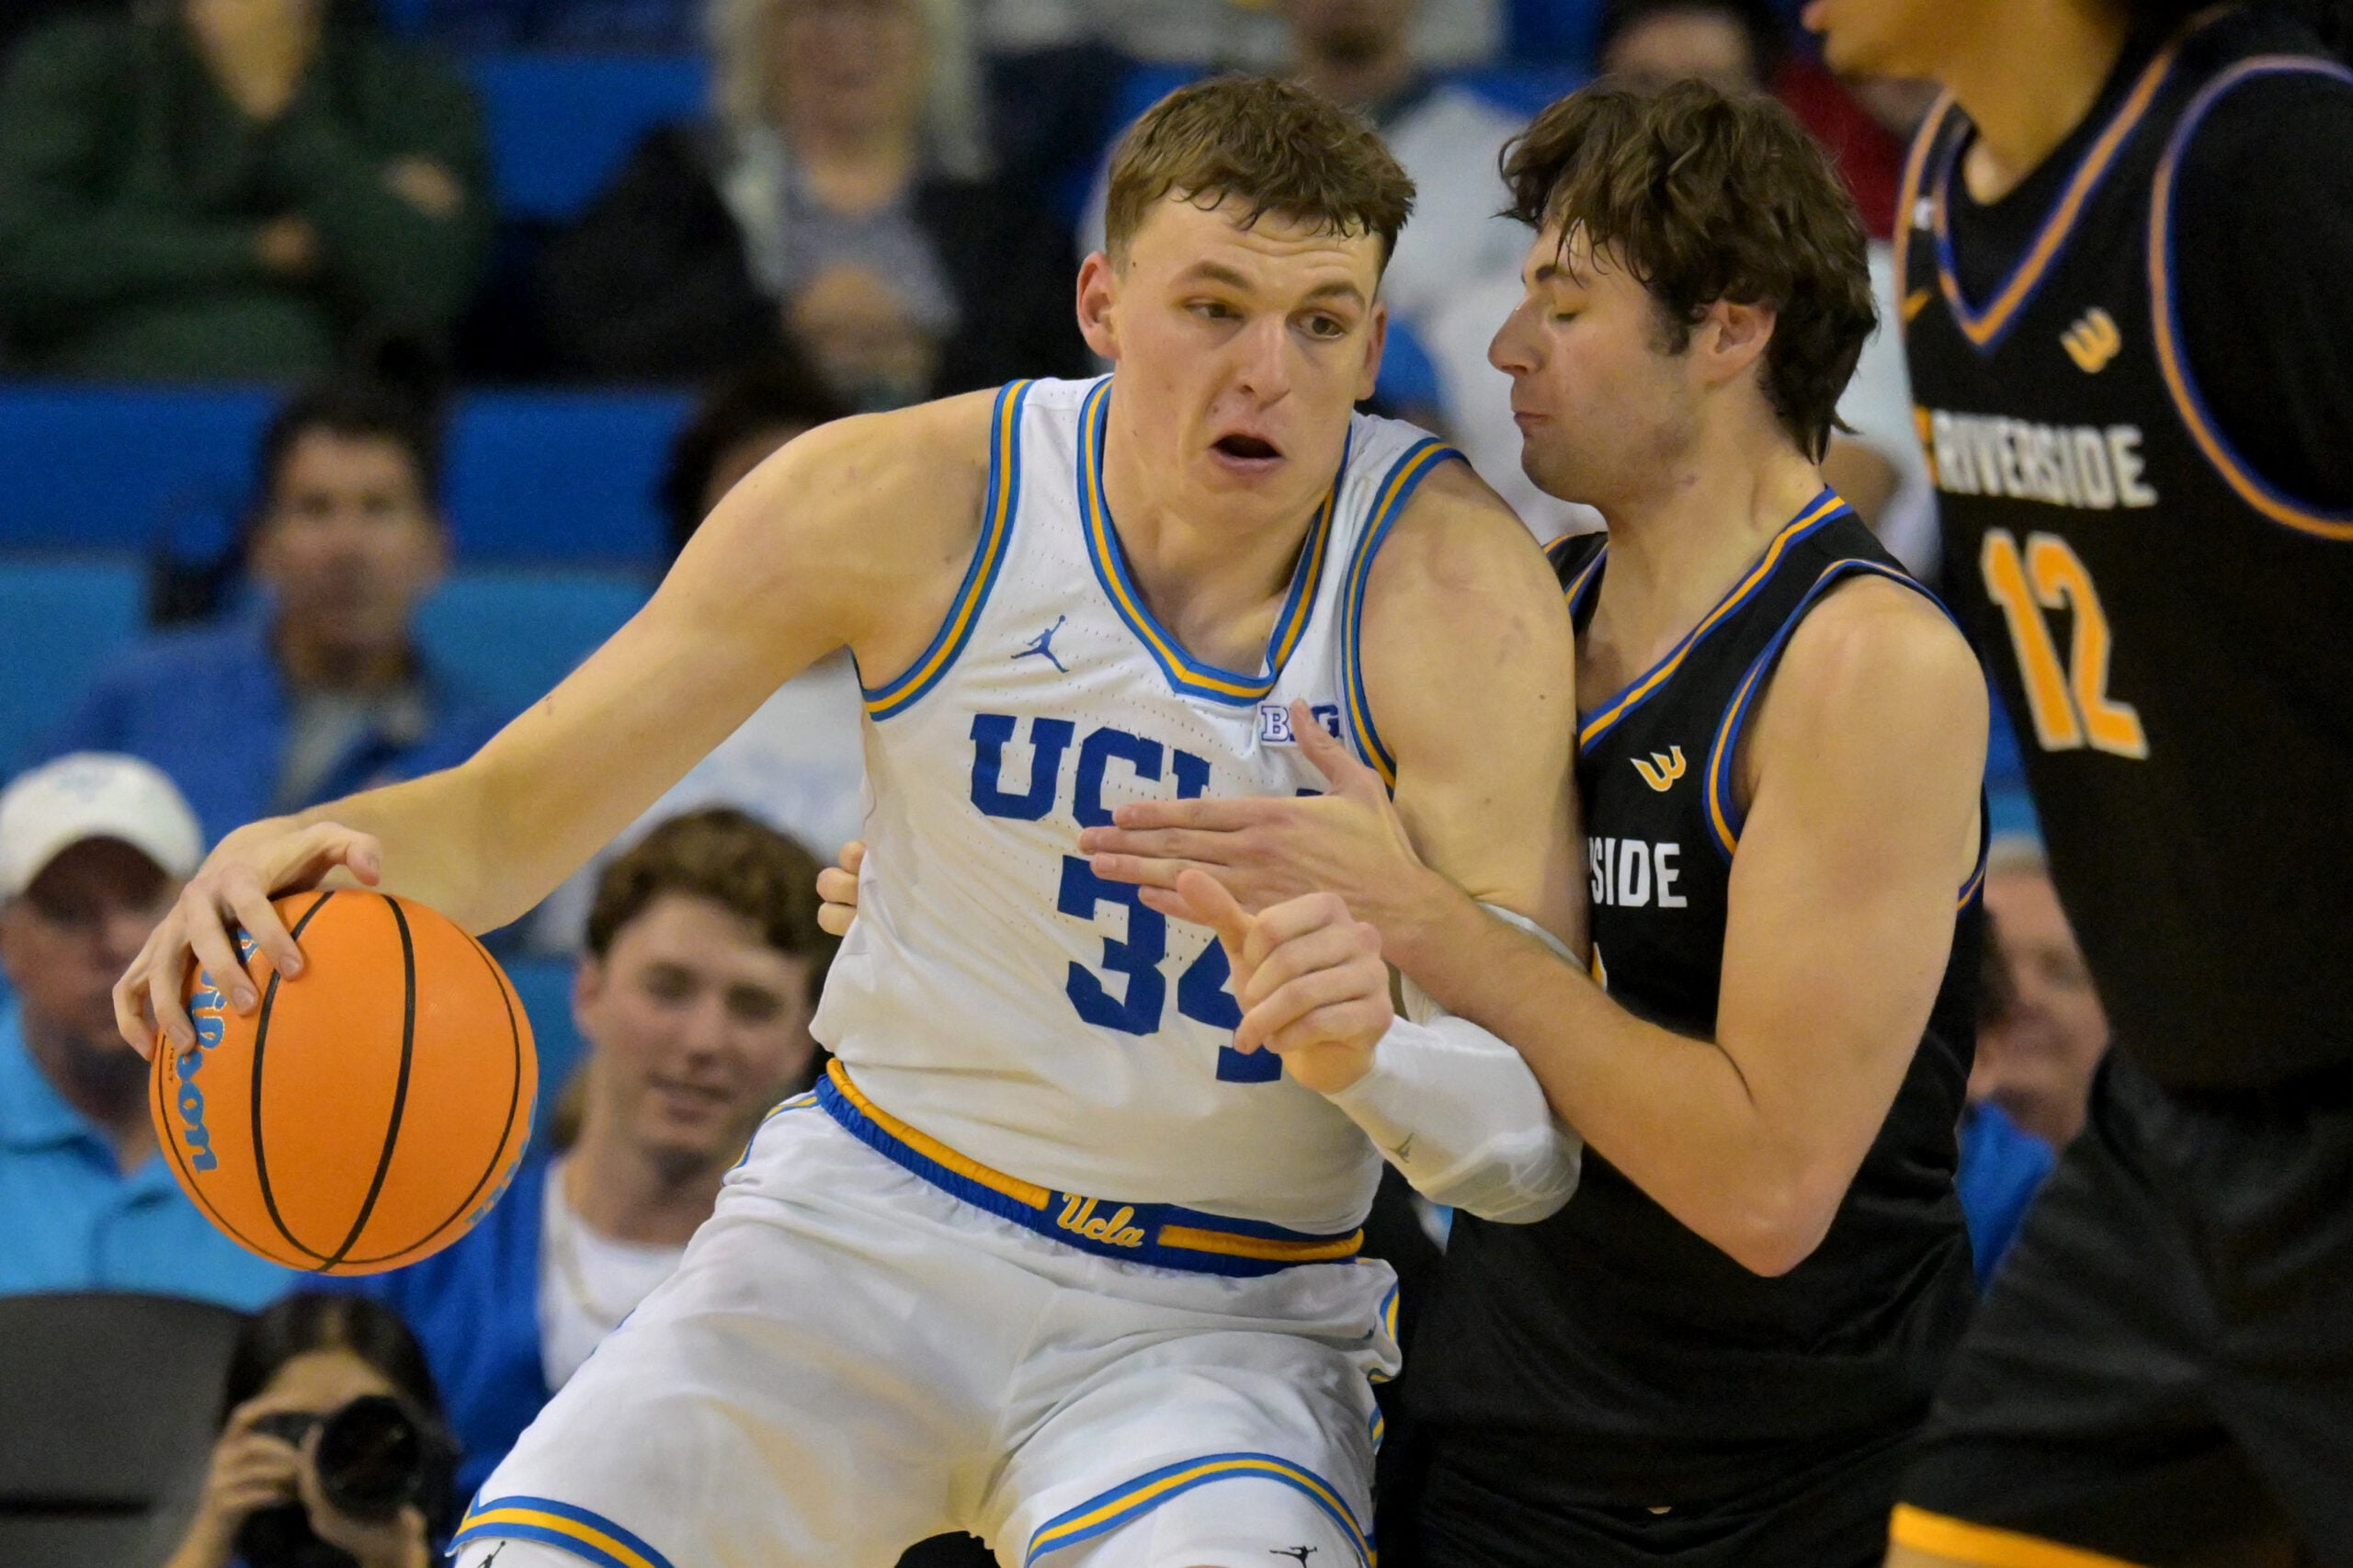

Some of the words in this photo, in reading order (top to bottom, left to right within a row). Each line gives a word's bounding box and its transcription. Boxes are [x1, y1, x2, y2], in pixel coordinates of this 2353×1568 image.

[1932, 409, 2157, 510] RIVERSIDE
[1981, 528, 2149, 760] 12
[970, 713, 1324, 829] UC
[1261, 705, 1340, 742] BG
[1588, 836, 1688, 907] SIDE
[176, 928, 259, 1173] ilson
